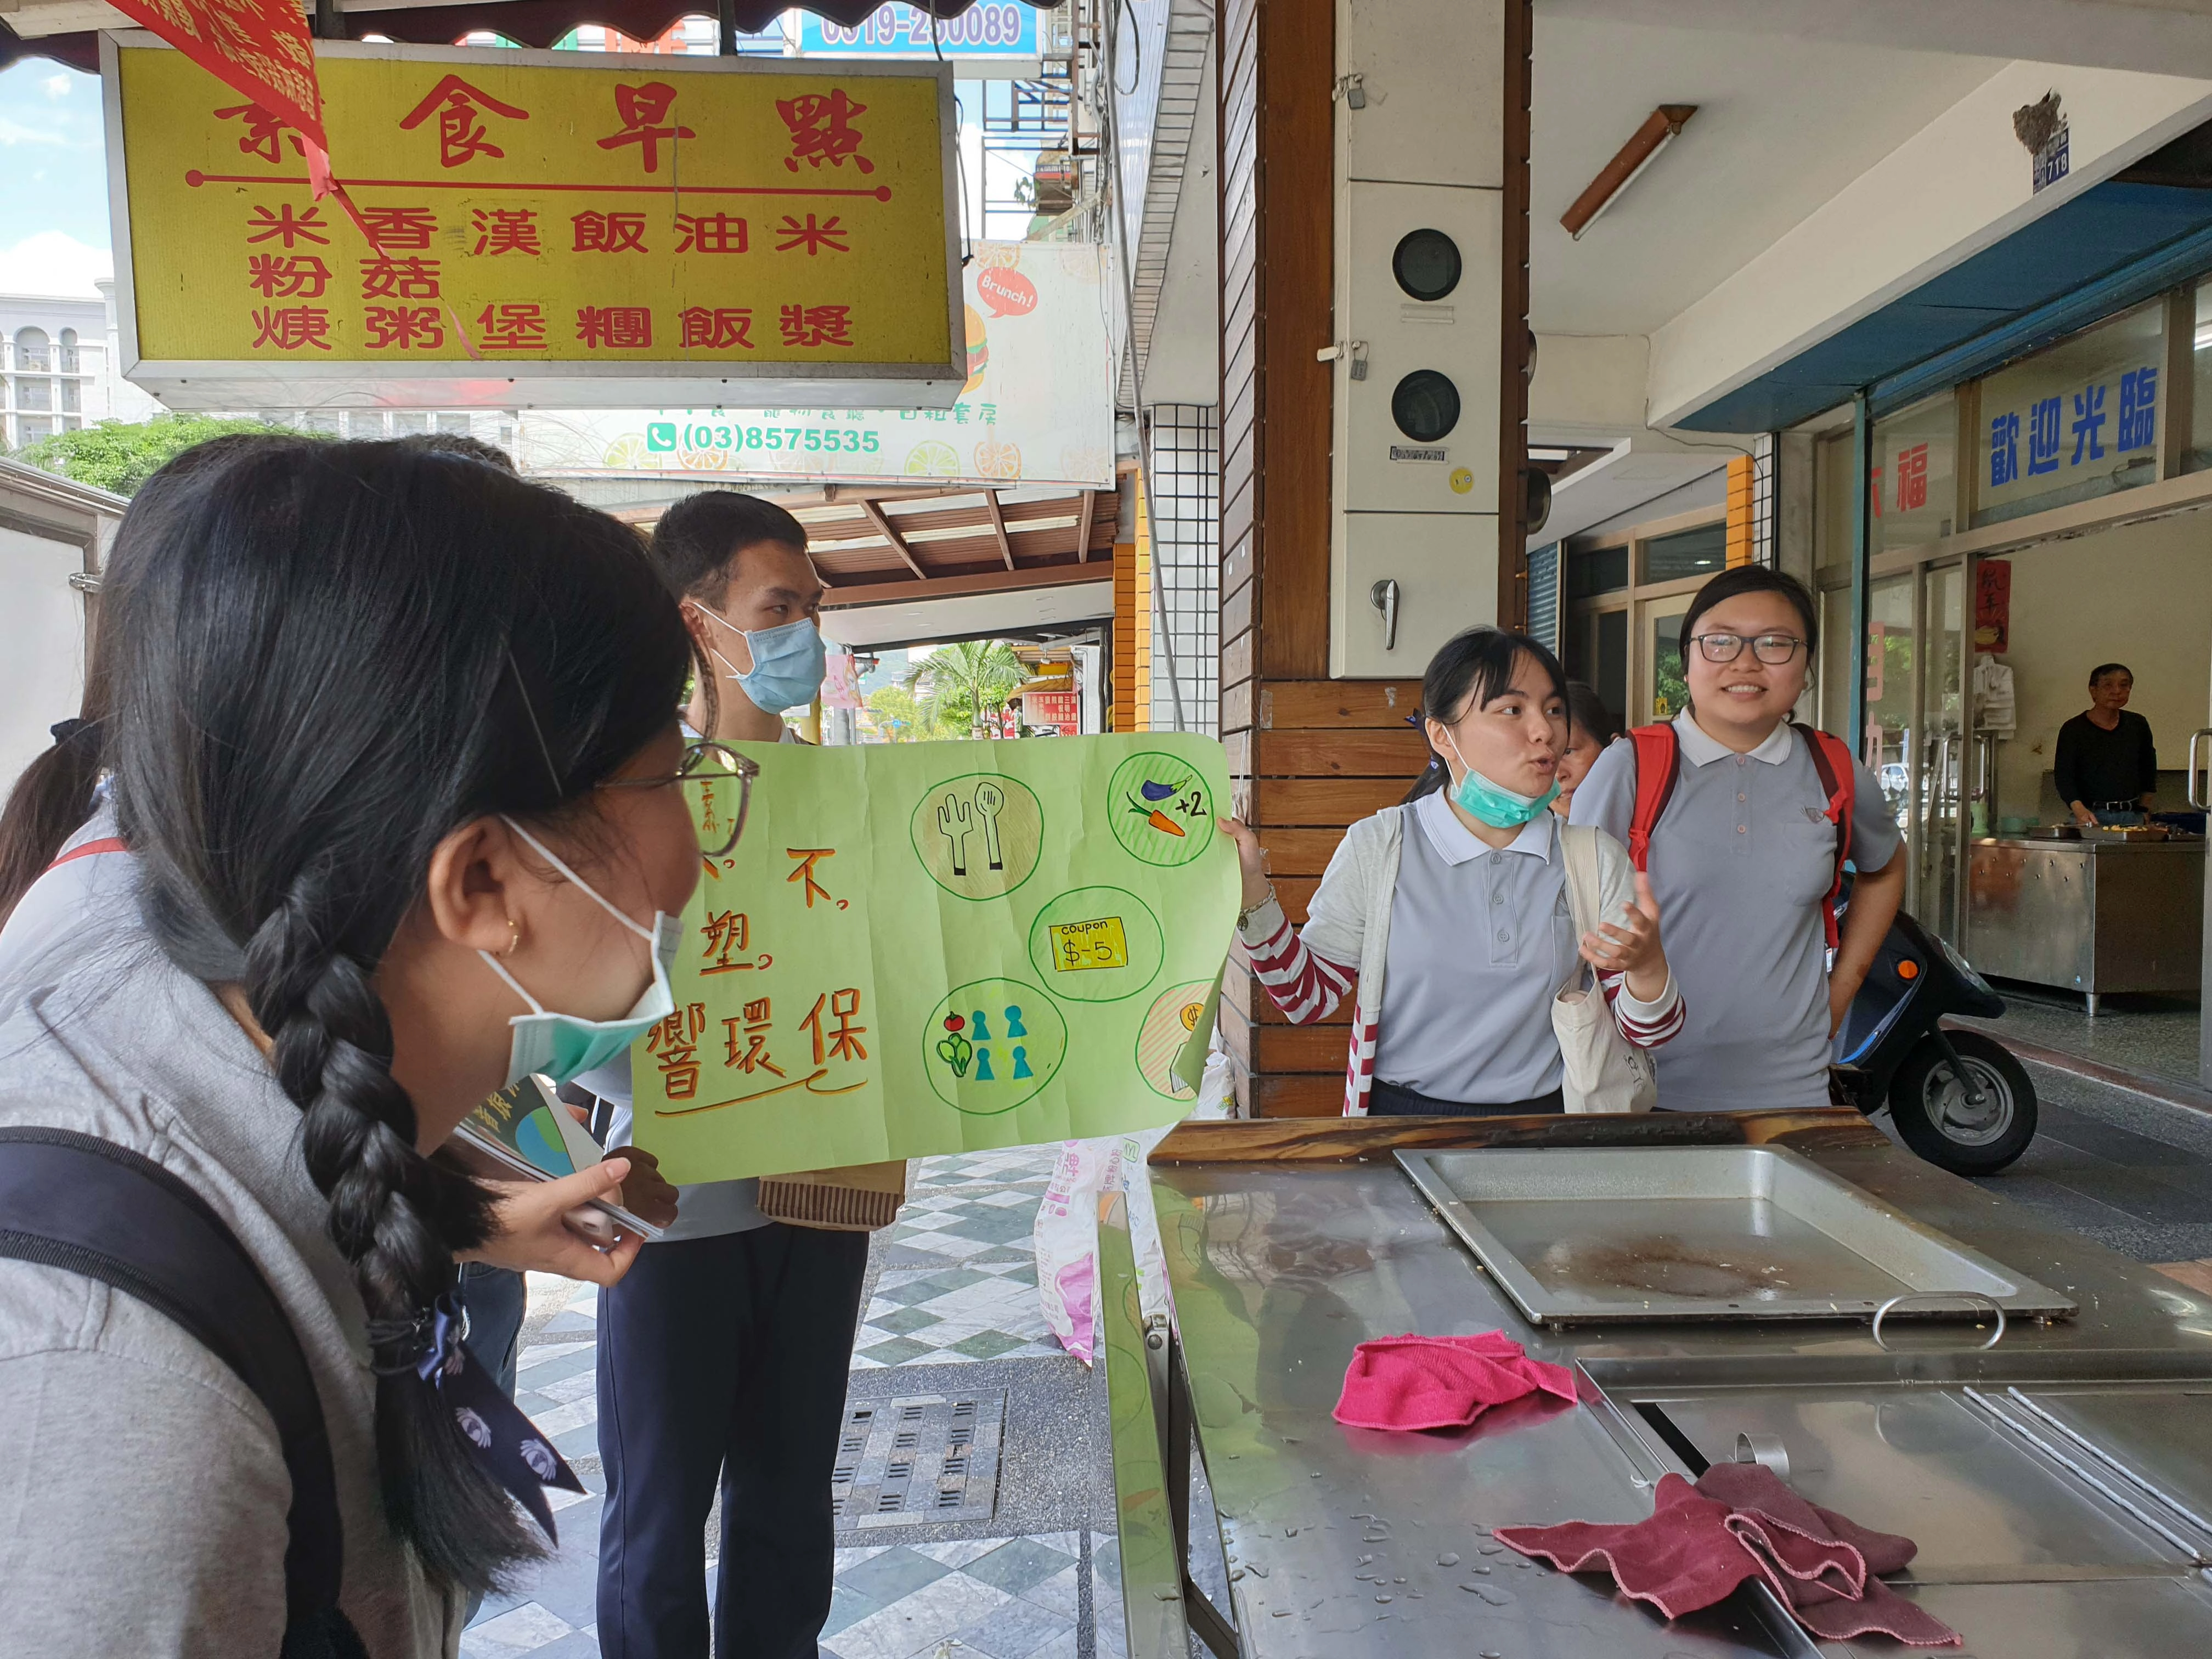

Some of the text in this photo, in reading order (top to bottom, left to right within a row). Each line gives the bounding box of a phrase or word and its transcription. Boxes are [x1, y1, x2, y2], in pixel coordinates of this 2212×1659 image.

[2048, 152, 2067, 180] 718
[359, 207, 444, 349] 香菇粥
[471, 208, 548, 350] 漢堡
[674, 213, 755, 349] 油飯
[981, 274, 1034, 307] Brunch!
[684, 423, 880, 453] (03)8575535
[1991, 366, 2157, 487] 歡迎光臨
[1175, 791, 1207, 816] +2
[1062, 921, 1108, 935] coupon
[646, 988, 867, 1099] 響環保
